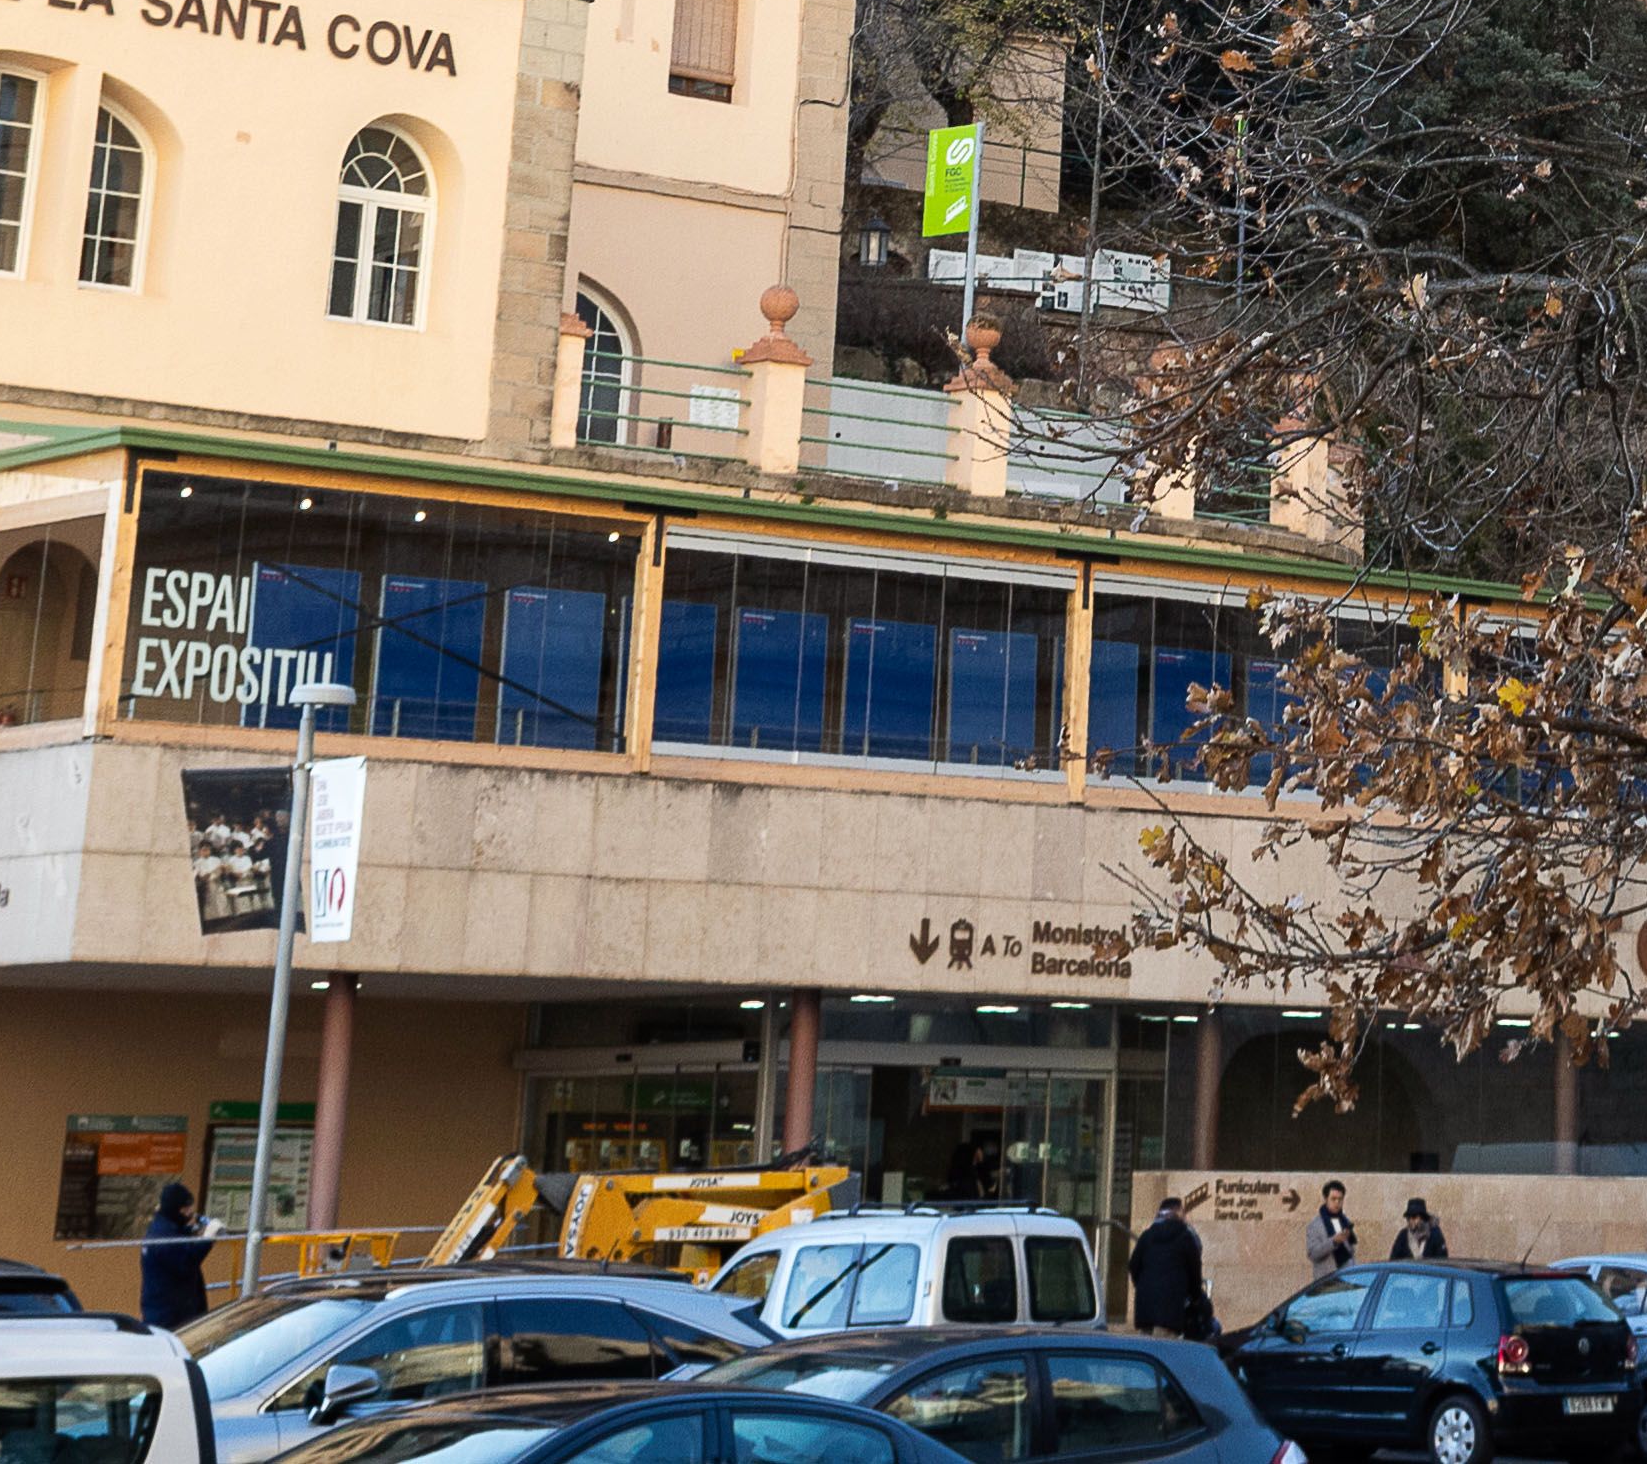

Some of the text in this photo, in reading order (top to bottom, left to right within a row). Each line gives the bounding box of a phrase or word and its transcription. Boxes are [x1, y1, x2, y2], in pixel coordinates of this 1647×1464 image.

[327, 14, 457, 77] COVA
[945, 168, 962, 177] FGC
[142, 567, 250, 634] ESPAI
[131, 637, 334, 708] EXPOSITIU
[981, 935, 996, 956] A
[1002, 935, 1023, 958] To
[1031, 952, 1132, 979] Barcelona
[1215, 1179, 1281, 1195] Funiculars
[1215, 1209, 1238, 1220] Santa
